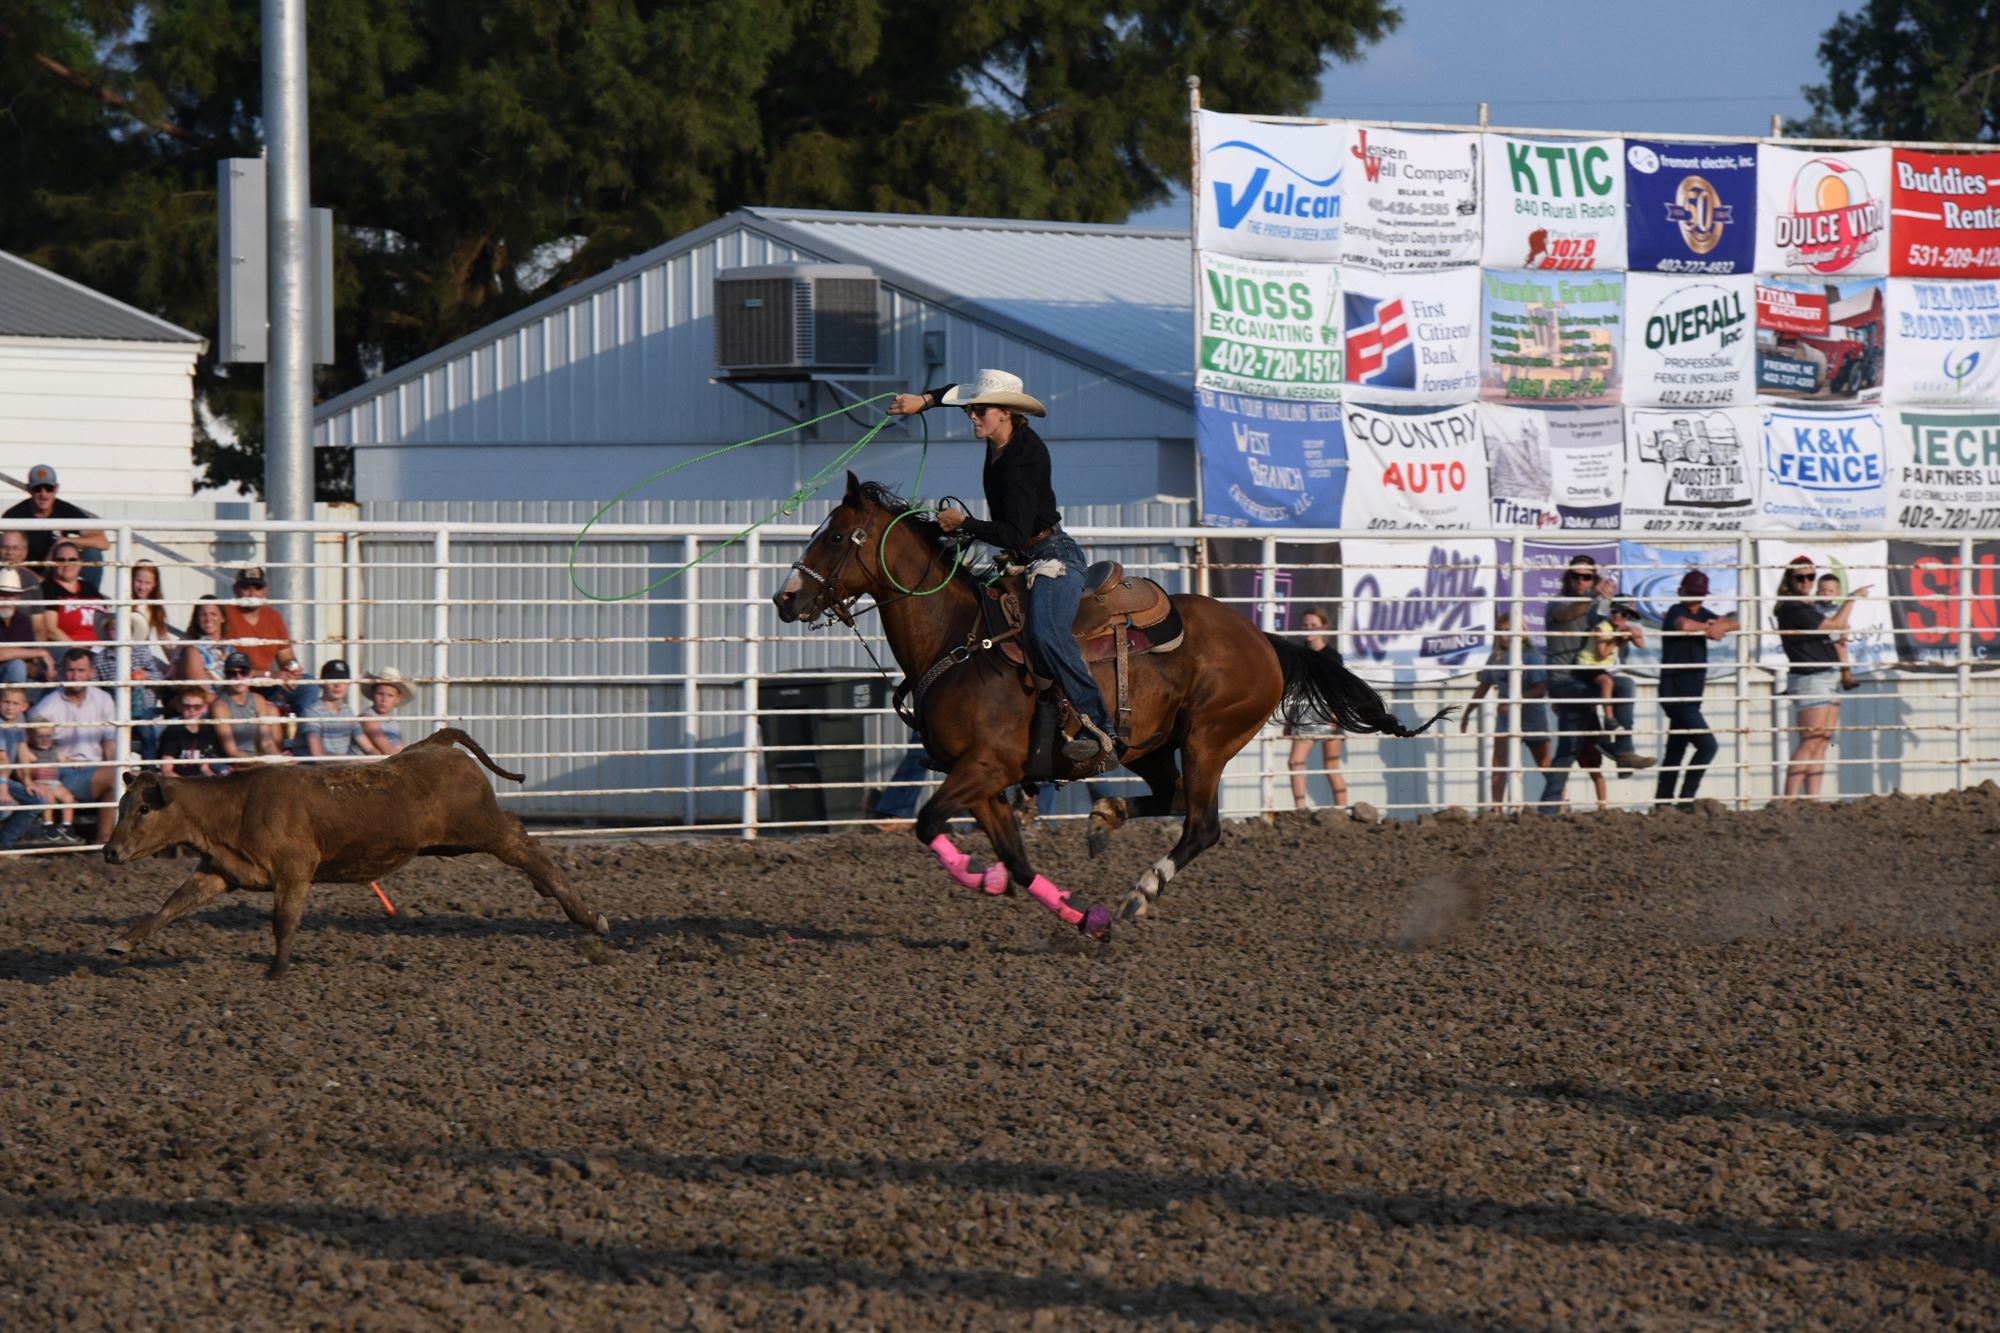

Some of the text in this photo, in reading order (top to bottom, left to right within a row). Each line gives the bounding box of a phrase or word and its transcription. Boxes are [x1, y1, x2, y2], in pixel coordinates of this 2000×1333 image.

[1350, 129, 1407, 160] Jensen
[1363, 156, 1471, 184] Well Company
[1506, 141, 1614, 198] KTIC
[1896, 160, 1988, 196] Buddies
[1213, 167, 1340, 230] Vulcan
[1514, 198, 1616, 219] 840 Rural Radio
[1775, 213, 1841, 248] DULCE
[1847, 202, 1883, 240] VID
[1404, 248, 1451, 258] DRILLING
[1551, 239, 1596, 258] 107.9
[1908, 243, 2000, 268] 531-209-412
[1206, 268, 1314, 321] VOSS
[1411, 300, 1446, 318] First
[1645, 290, 1746, 350] OVERALL
[1210, 312, 1314, 343] EXCAVATING
[1899, 311, 1965, 340] RODEO
[1210, 340, 1341, 381] 402-720-1512
[1421, 344, 1458, 365] Bank
[1201, 374, 1279, 397] ARLINGTON
[1653, 370, 1740, 385] FENCE INSTALLERS
[1348, 406, 1477, 449] COUNTRY
[1793, 426, 1862, 454] K&K
[1382, 461, 1467, 494] AUTO
[1672, 466, 1721, 486] ROOSTER
[1779, 453, 1881, 483] FENCE
[1902, 467, 1984, 487] PARTNERS
[1493, 498, 1542, 526] Titan
[1898, 504, 2000, 529] 402-721-177
[1353, 545, 1487, 664] Quality
[1426, 633, 1479, 655] TOWING
